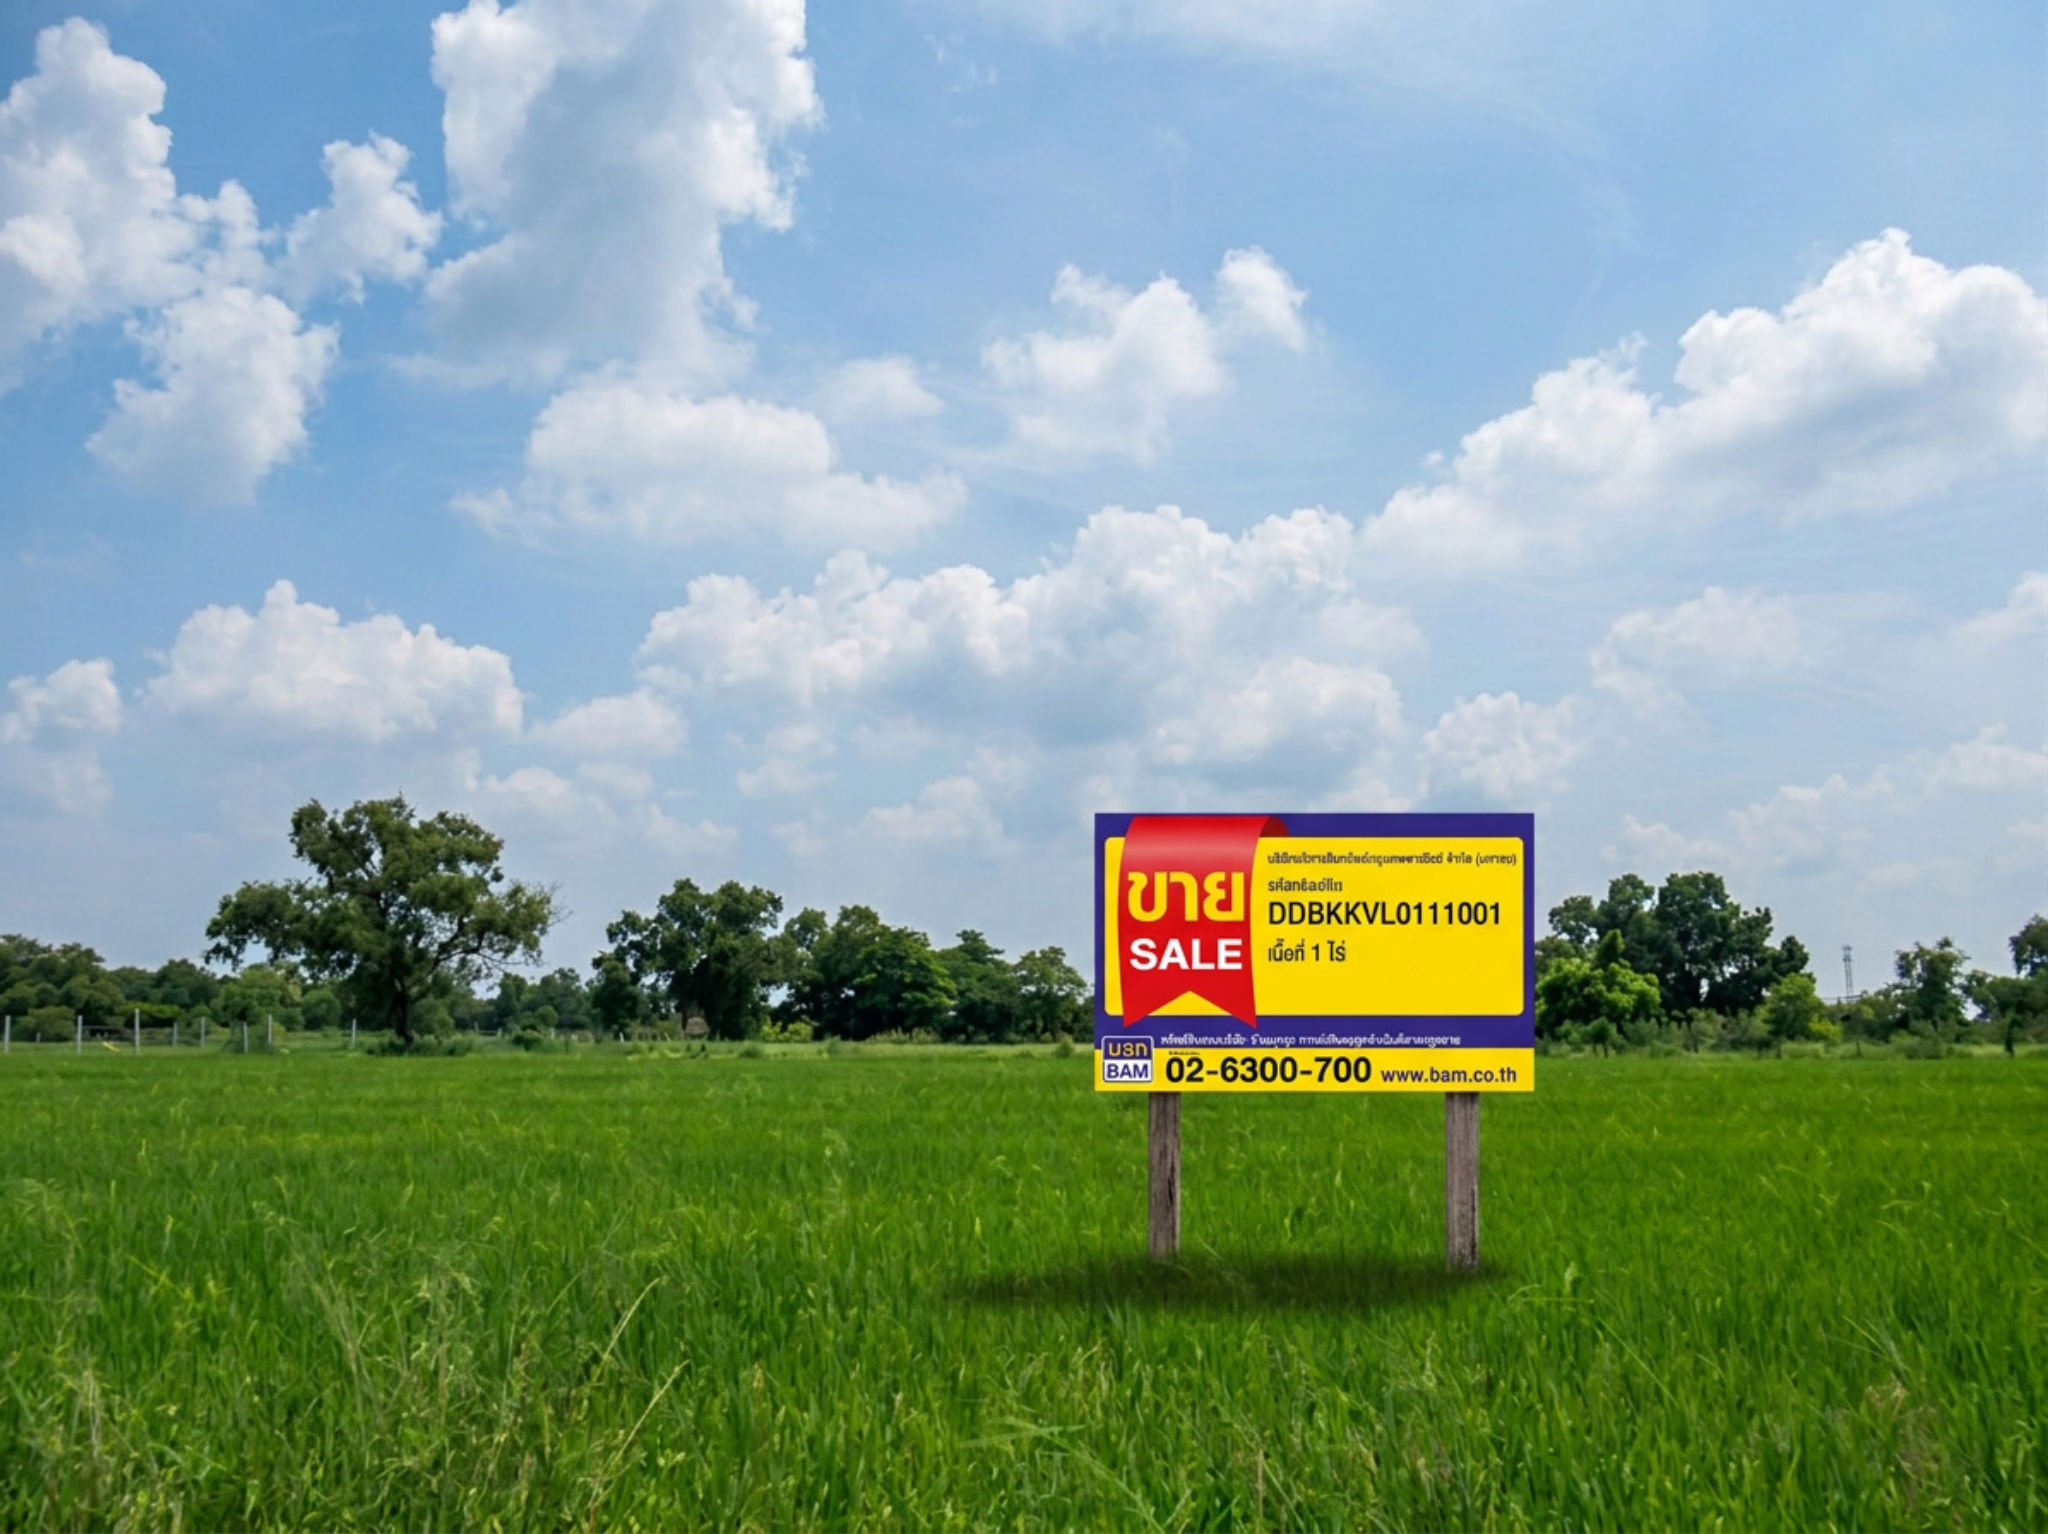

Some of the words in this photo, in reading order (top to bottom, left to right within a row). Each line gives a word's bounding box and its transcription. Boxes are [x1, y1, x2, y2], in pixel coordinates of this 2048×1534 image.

[1127, 871, 1245, 922] ขาย
[1268, 901, 1500, 926] DDBKKVL0111001
[1129, 937, 1243, 971] SALE
[1311, 943, 1320, 962] 1
[1327, 940, 1347, 963] ไร่
[1106, 1062, 1149, 1080] BAM
[1165, 1056, 1372, 1084] 02-6300-700
[1380, 1065, 1518, 1084] www.bam.co.th
